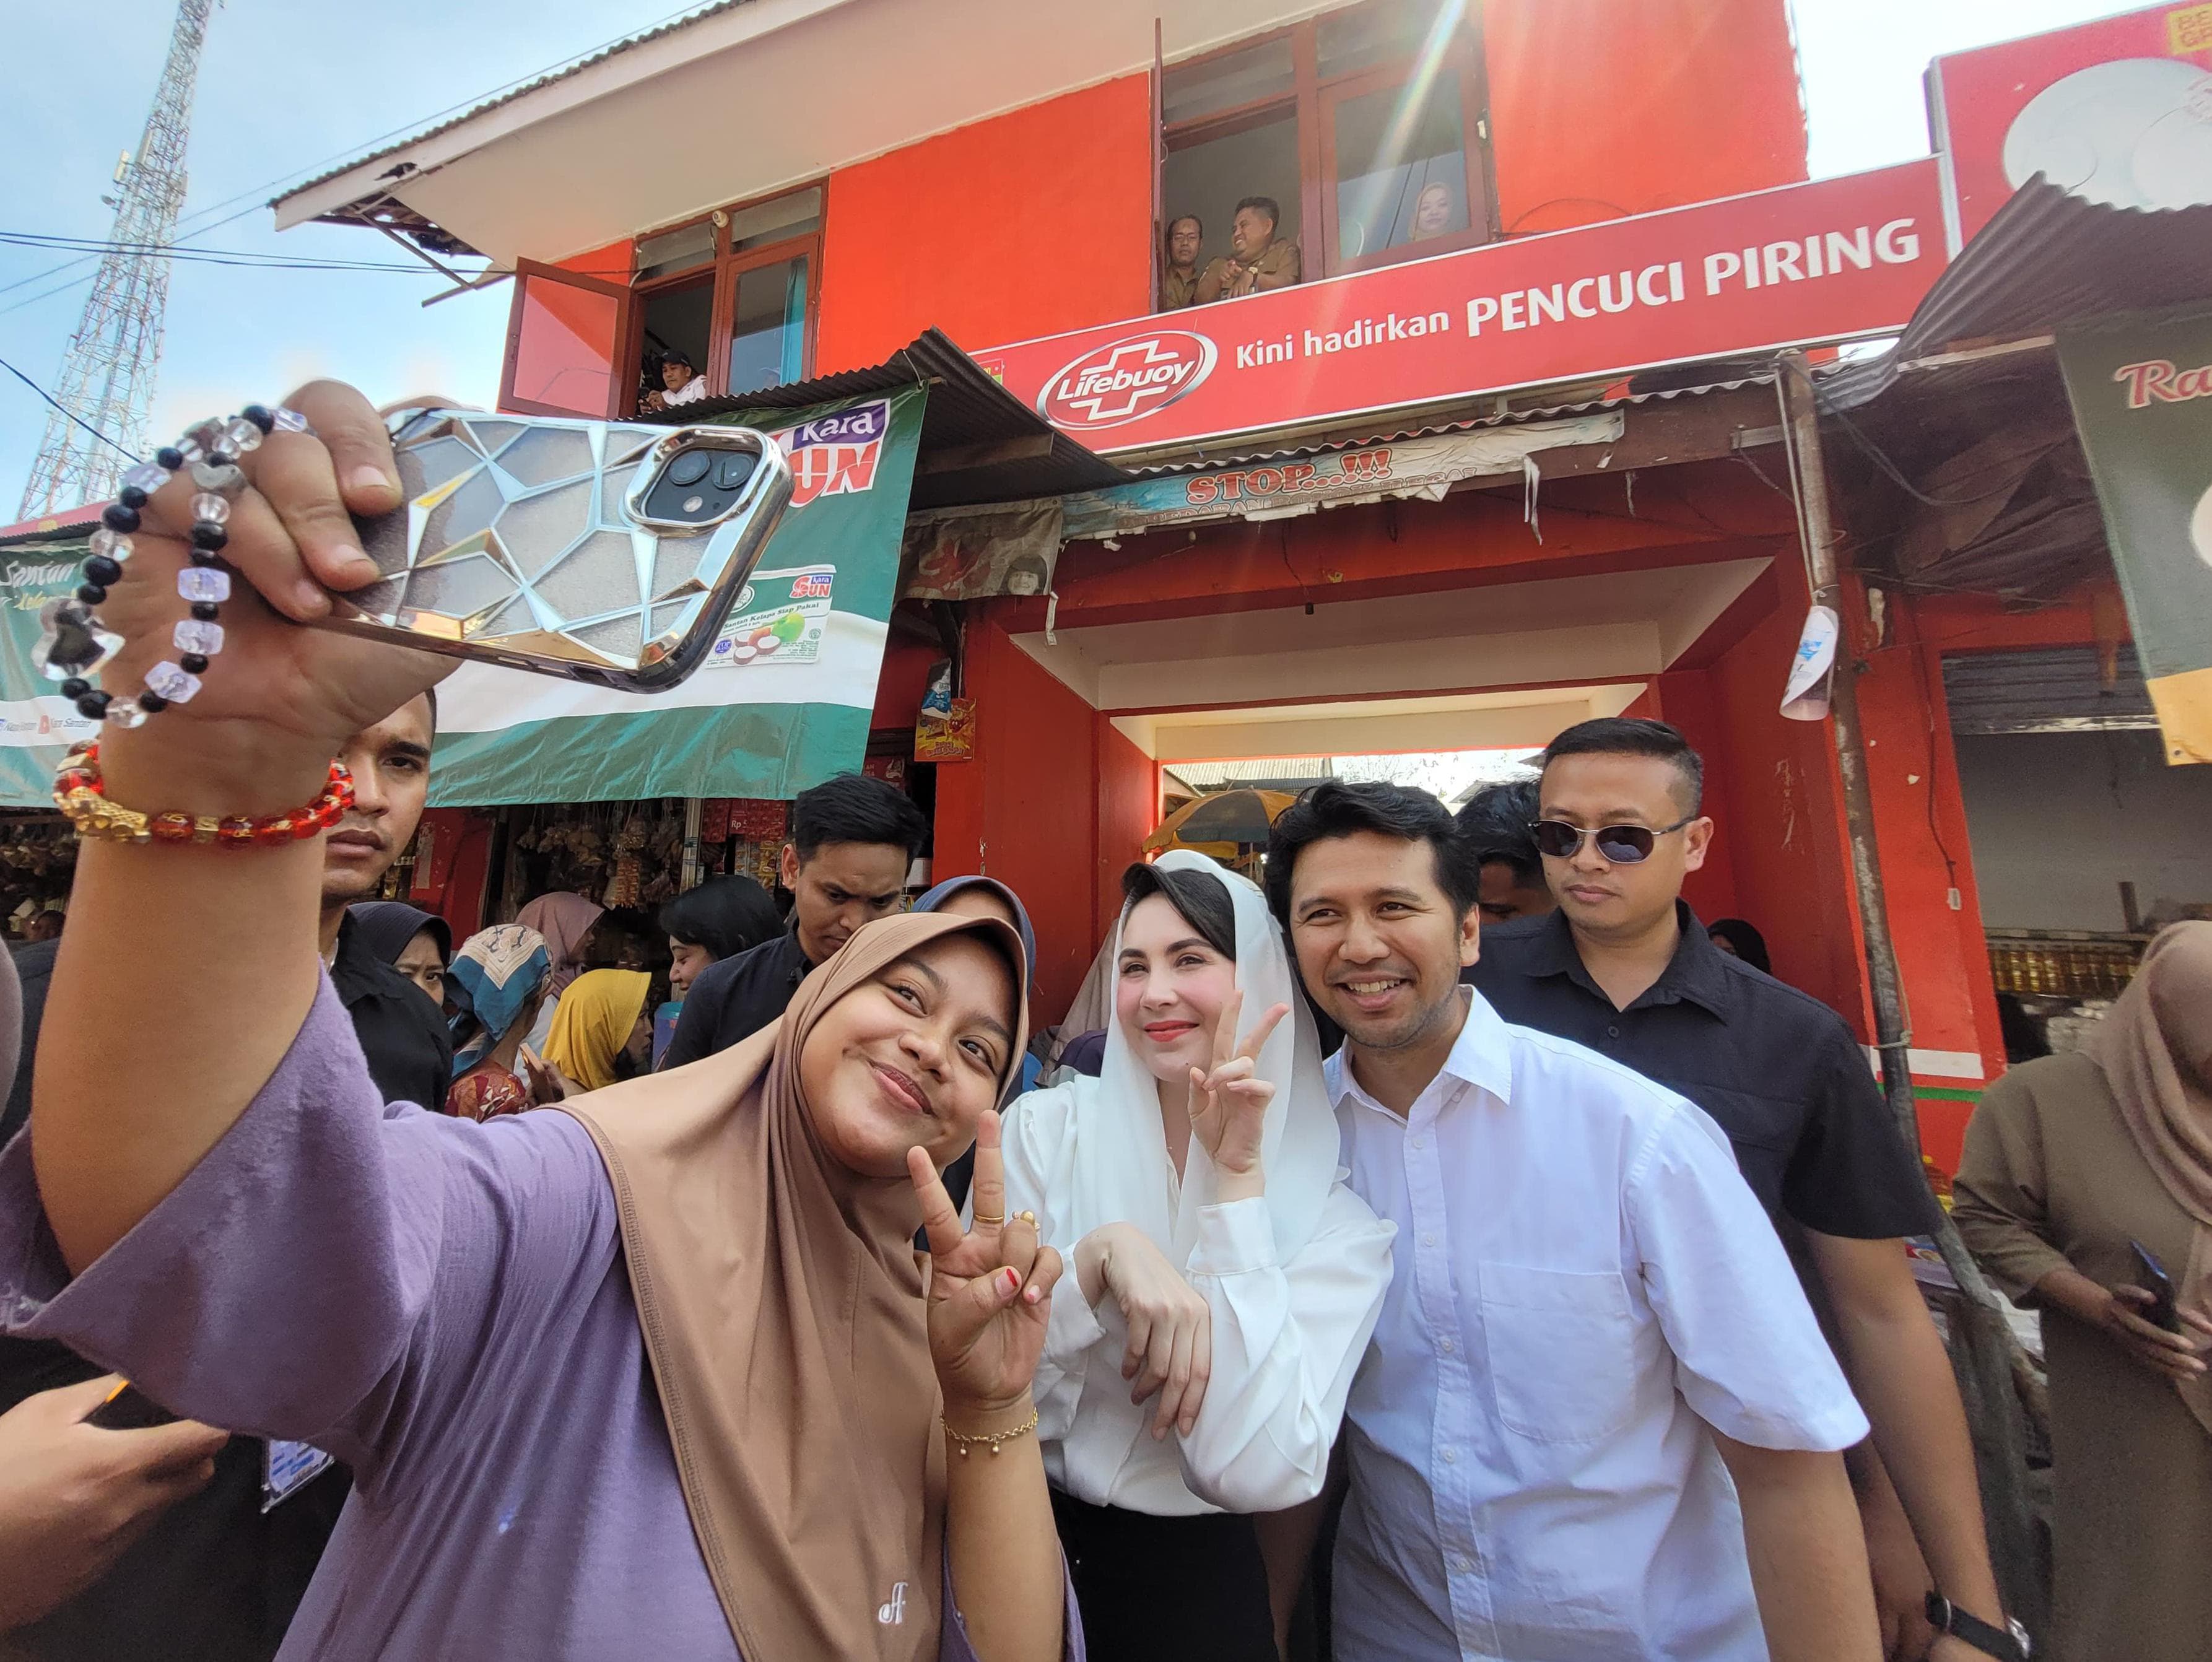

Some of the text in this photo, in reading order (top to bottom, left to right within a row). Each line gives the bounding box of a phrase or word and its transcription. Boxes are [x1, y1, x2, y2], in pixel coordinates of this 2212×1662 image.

[1237, 217, 1920, 369] Kini hadirkan PENCUCI PIRING
[1056, 360, 1195, 401] Lifebuoy
[787, 440, 879, 508] UN
[723, 618, 748, 629] Santan
[751, 612, 775, 621] Kelapa
[777, 607, 794, 616] Siap
